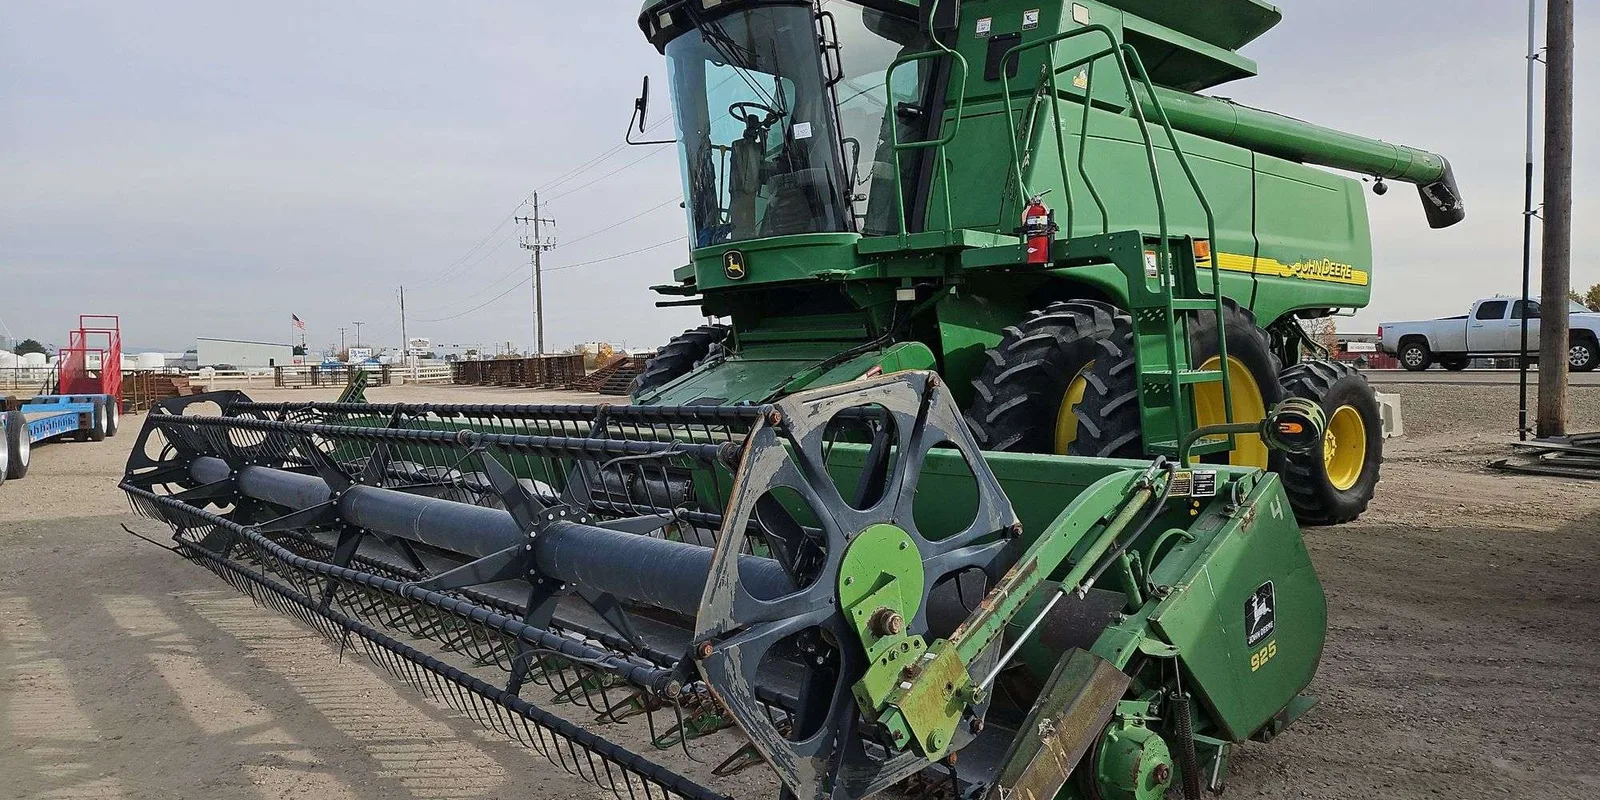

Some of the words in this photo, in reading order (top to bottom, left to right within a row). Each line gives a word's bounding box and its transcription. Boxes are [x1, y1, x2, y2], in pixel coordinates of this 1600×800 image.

[1322, 258, 1352, 279] DEERE
[1248, 630, 1261, 645] JOHN
[1261, 621, 1274, 636] DEERE
[1250, 639, 1277, 672] 925
